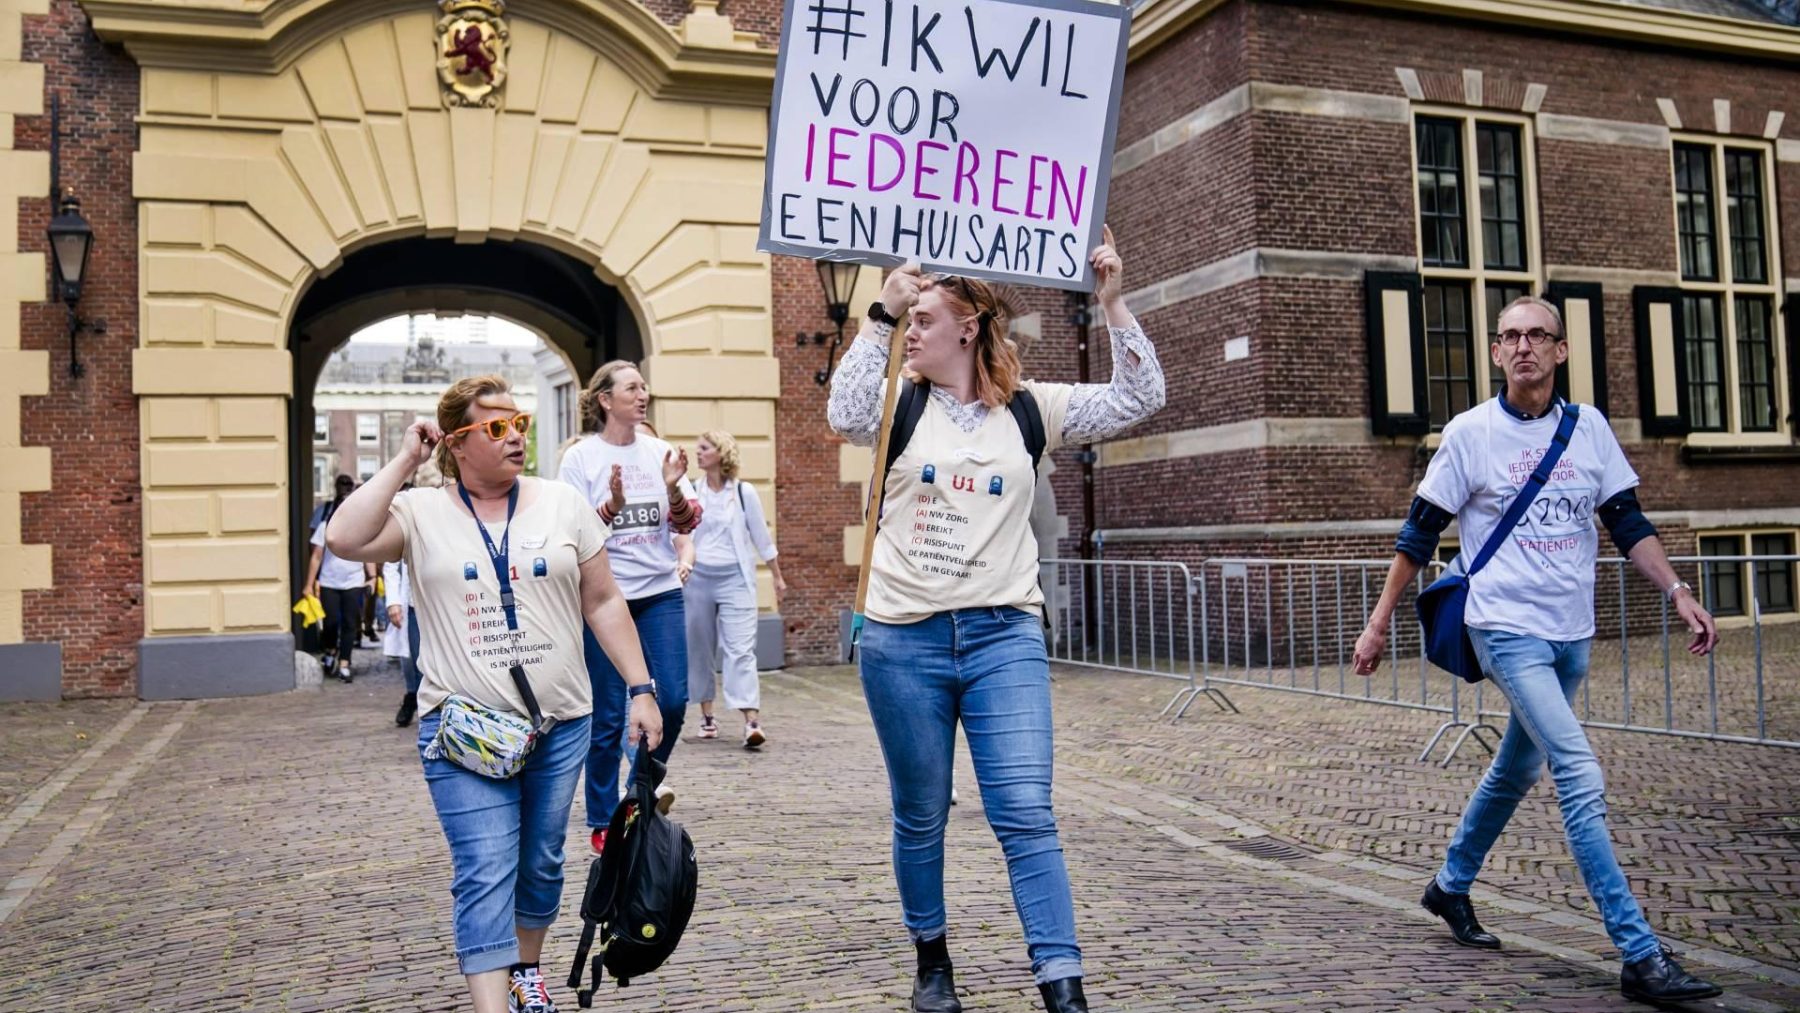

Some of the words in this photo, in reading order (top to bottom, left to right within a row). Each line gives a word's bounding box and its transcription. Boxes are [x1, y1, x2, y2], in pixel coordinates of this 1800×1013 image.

[807, 0, 943, 74] #IK
[965, 5, 1088, 99] WIL
[810, 72, 960, 142] VOOR
[805, 123, 1088, 226] IEDEREEN
[781, 193, 877, 249] EEN
[891, 204, 1077, 278] HUISARTS
[1521, 449, 1533, 460] IK
[1536, 447, 1549, 459] ST
[1508, 460, 1540, 474] IEDER
[952, 475, 975, 492] U1
[918, 495, 930, 505] (D)
[932, 497, 937, 505] E
[916, 508, 928, 518] (A)
[929, 510, 944, 519] NW
[945, 513, 969, 524] ZORG
[914, 522, 925, 532] (B)
[926, 524, 953, 535] EREIKT
[911, 536, 922, 545] (C)
[923, 537, 966, 552] RISISPUNT
[908, 549, 918, 557] DE
[922, 564, 929, 572] IS
[931, 565, 939, 573] IN
[465, 593, 478, 603] (D)
[480, 592, 485, 600] E
[467, 607, 479, 617] (A)
[481, 605, 497, 614] NW
[498, 604, 523, 613] ZG
[469, 621, 480, 631] (B)
[482, 619, 507, 629] EREIK
[469, 636, 481, 646] (C)
[471, 650, 481, 658] DE
[490, 661, 498, 669] IS
[499, 660, 508, 668] IN
